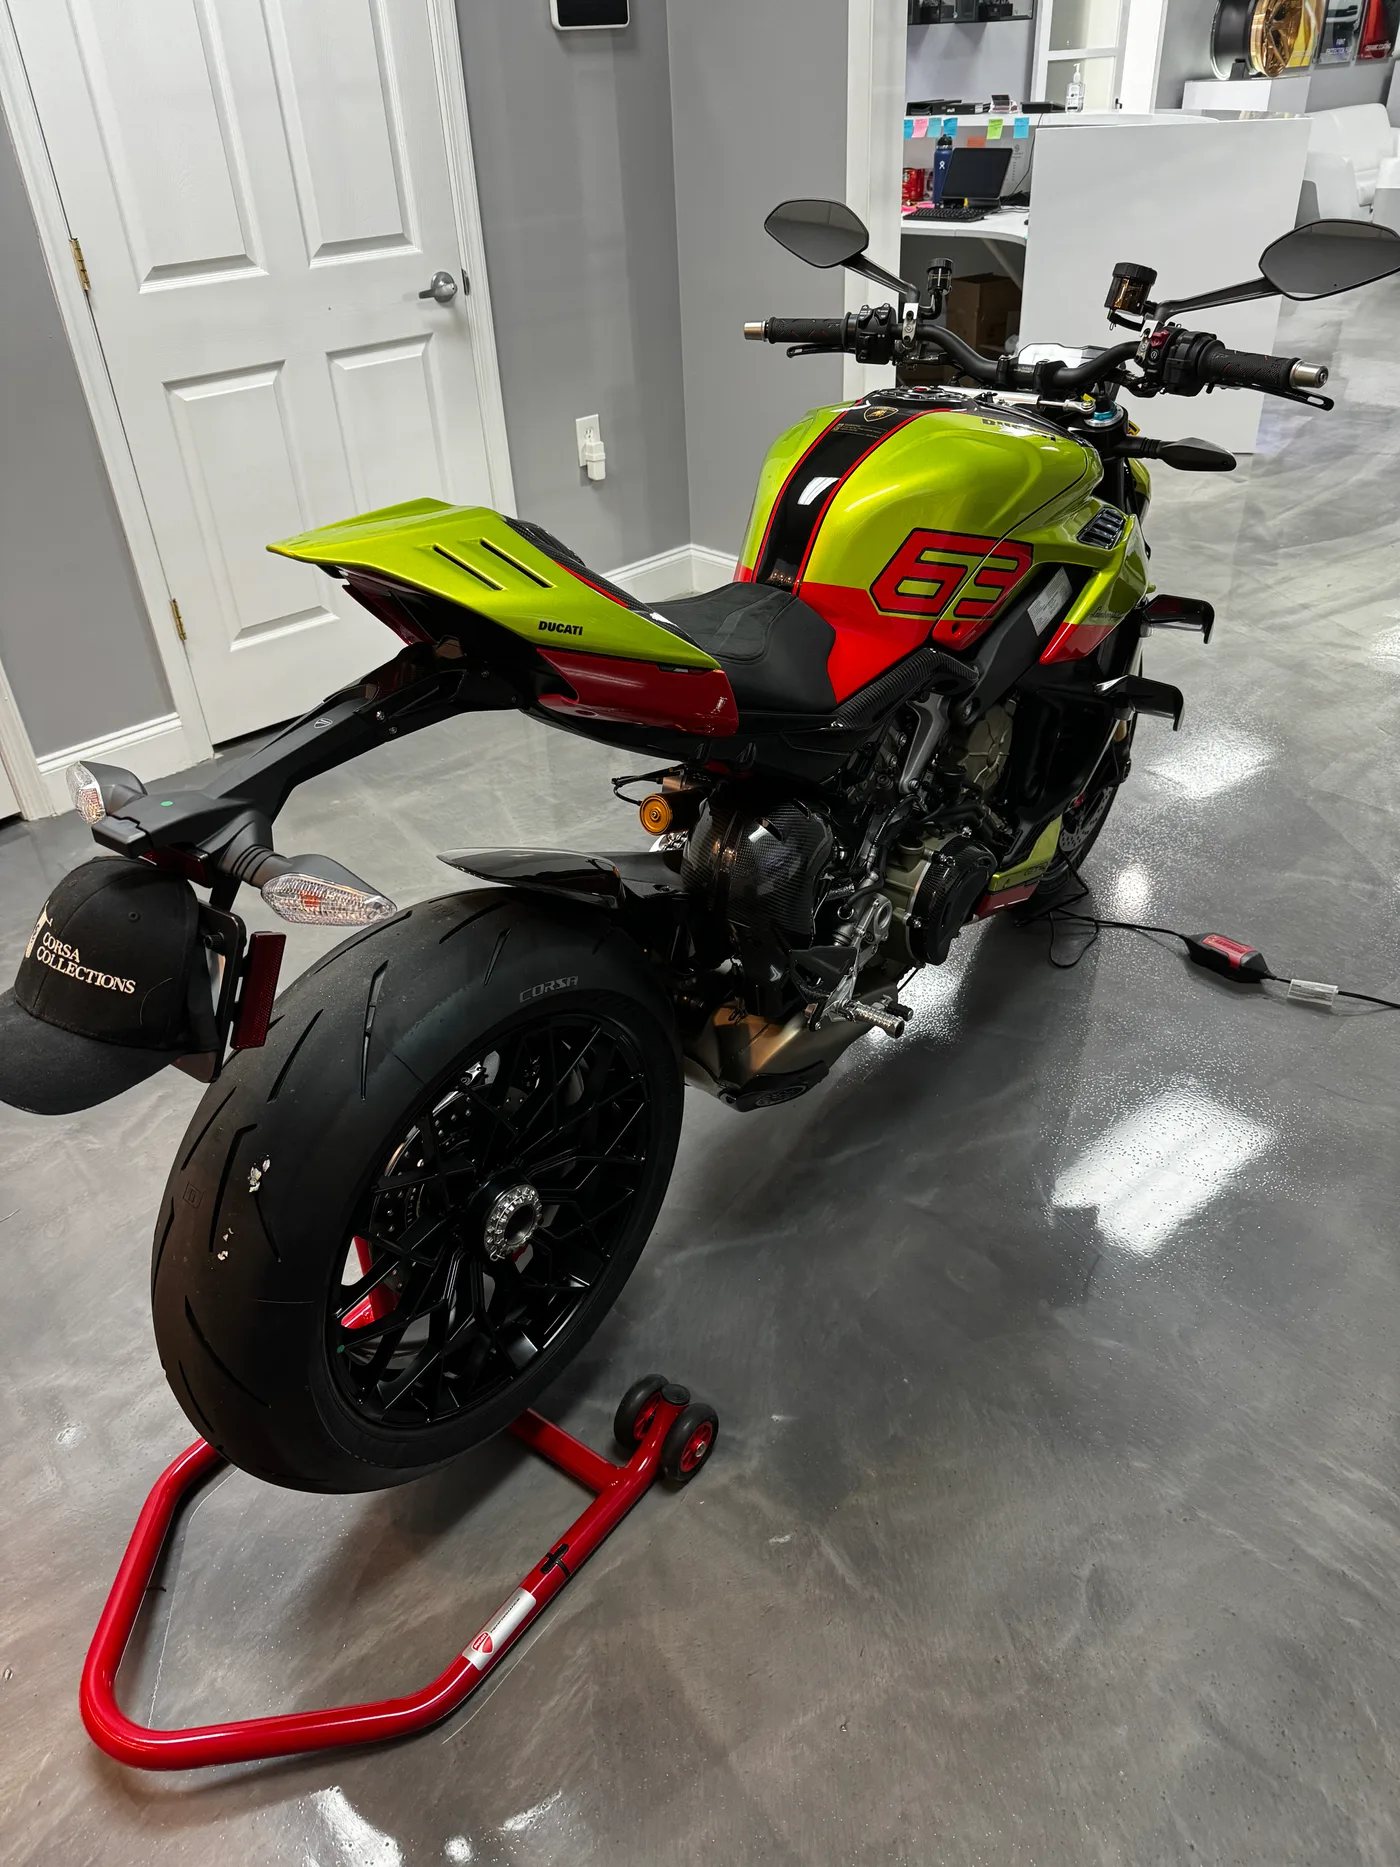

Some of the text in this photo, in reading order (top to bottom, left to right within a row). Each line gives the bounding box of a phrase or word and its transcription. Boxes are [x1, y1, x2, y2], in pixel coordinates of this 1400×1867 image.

[869, 527, 1034, 619] 63
[538, 620, 583, 636] DUCATI
[43, 931, 80, 963] CORSA
[37, 946, 136, 994] COLLECTIONS
[520, 976, 578, 1003] CORSA
